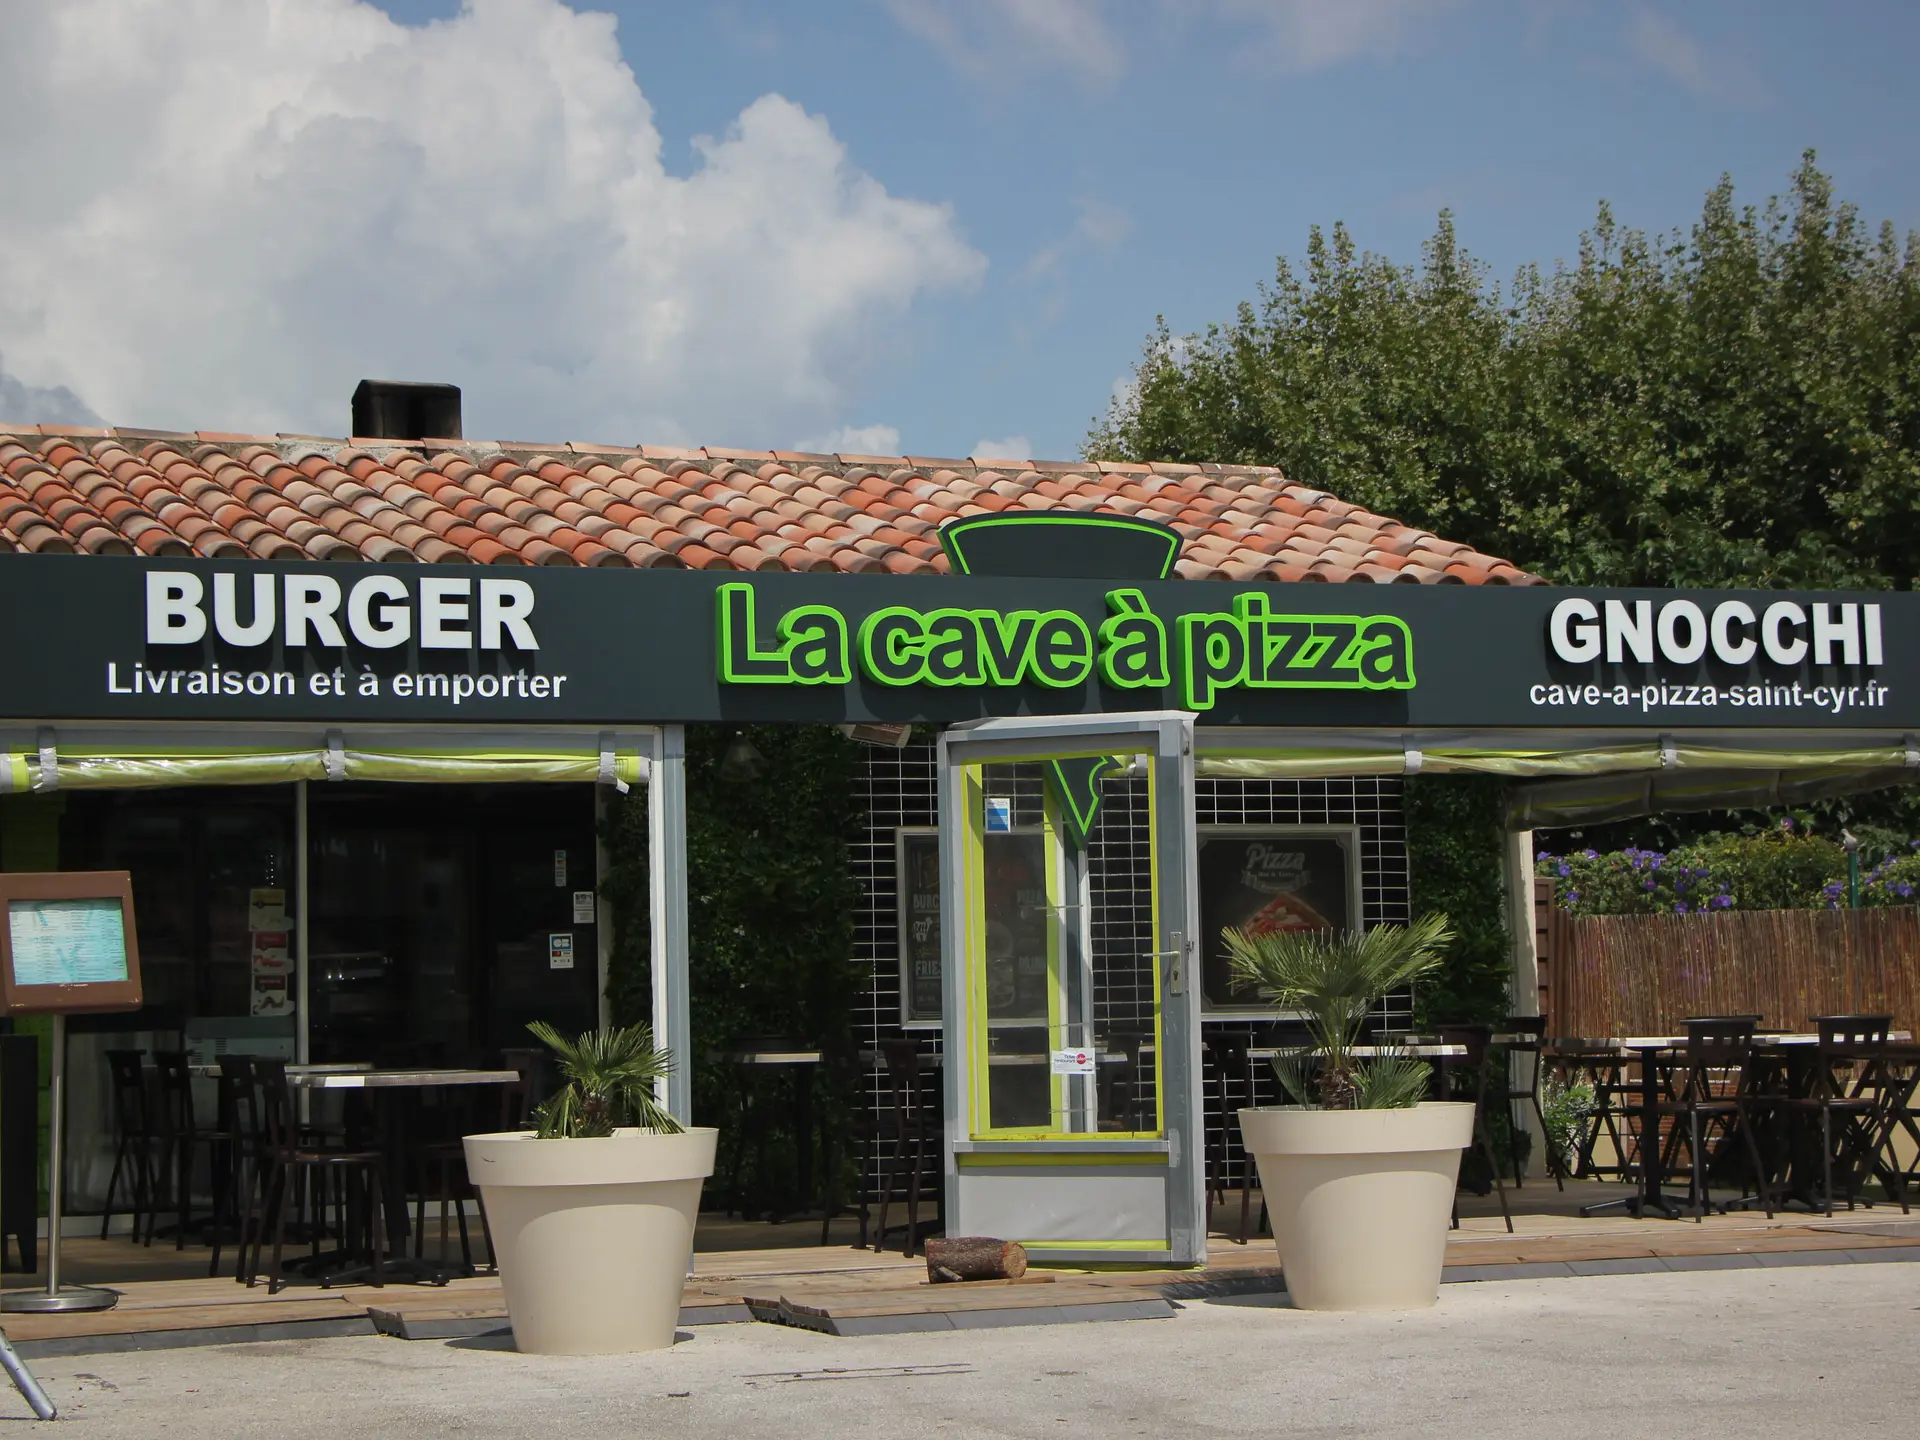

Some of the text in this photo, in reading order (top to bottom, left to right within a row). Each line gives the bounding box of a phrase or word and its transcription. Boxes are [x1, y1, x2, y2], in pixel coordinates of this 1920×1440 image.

[146, 571, 540, 650] BURGER
[1550, 597, 1883, 665] GNOCCHI
[717, 582, 1417, 711] La cave à pizza
[107, 662, 568, 705] Livraison et à emporter
[1529, 678, 1889, 714] cave-a-pizza-saint-cyr.fr
[1246, 842, 1306, 871] Pizza
